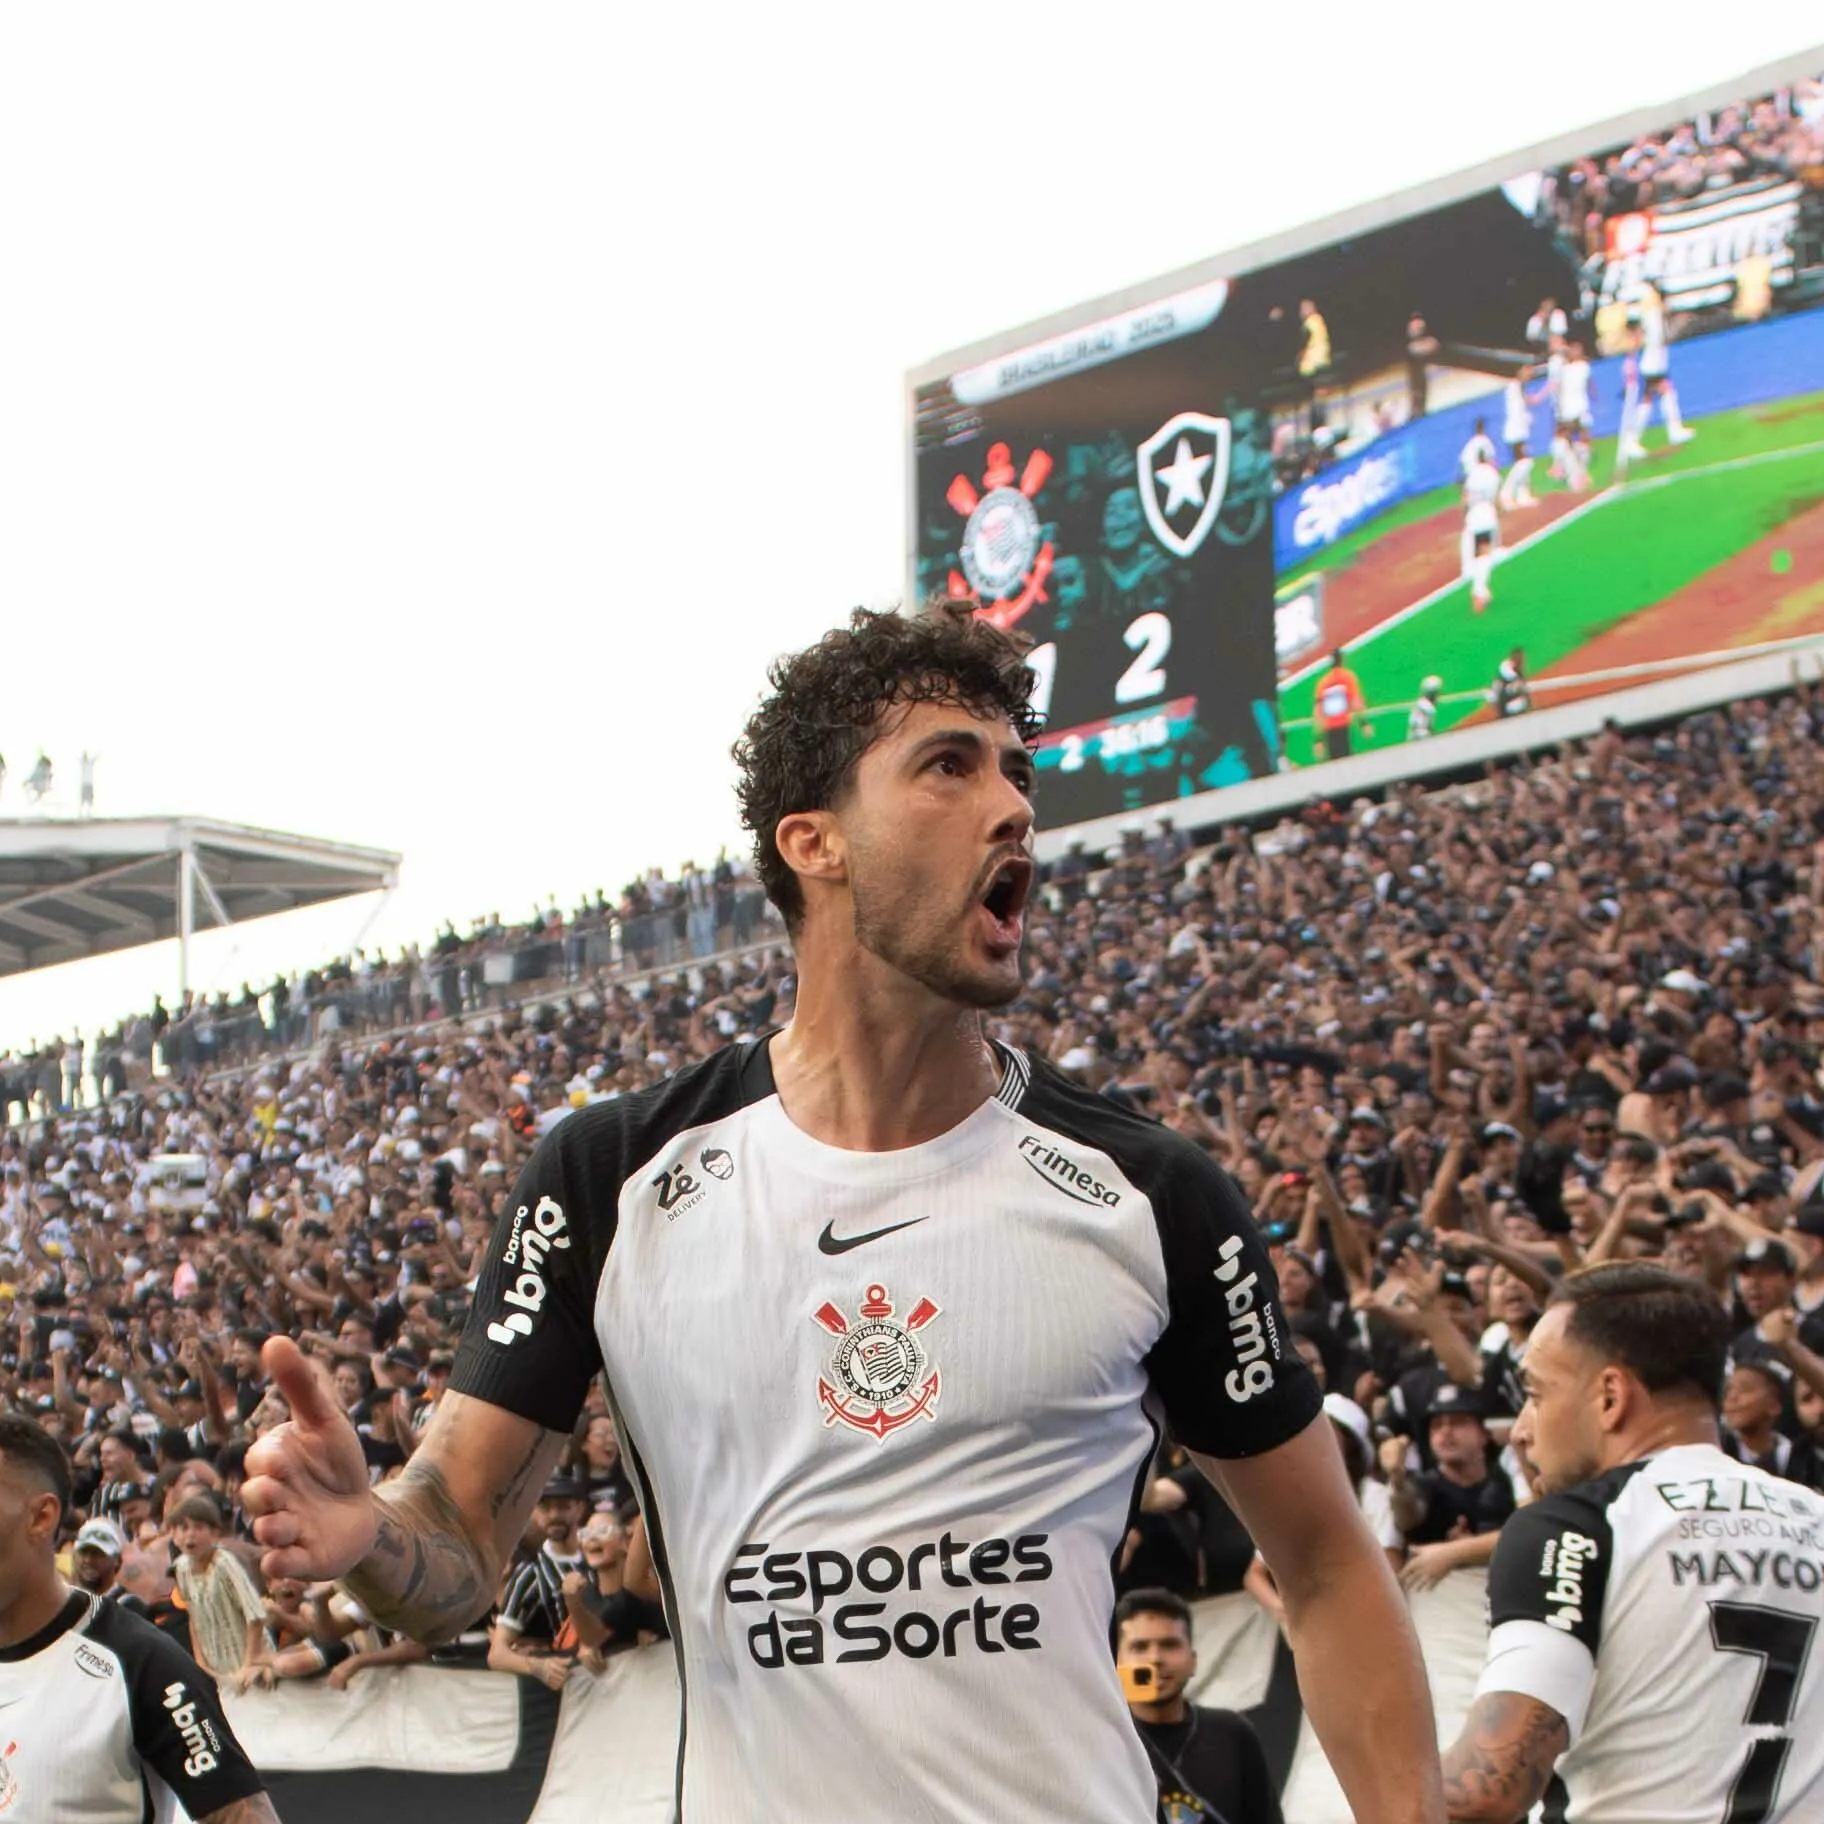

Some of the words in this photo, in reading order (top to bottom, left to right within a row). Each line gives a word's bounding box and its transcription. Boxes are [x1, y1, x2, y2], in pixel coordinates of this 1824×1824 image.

[1114, 611, 1172, 704] 2
[652, 1164, 701, 1211] Zé
[1018, 1135, 1121, 1208] Frimesa
[503, 1205, 529, 1265] banco
[667, 1191, 708, 1223] DELIVERY
[504, 1195, 571, 1313] bmg
[1224, 1271, 1275, 1404] bmg
[1263, 1302, 1280, 1361] banco
[868, 1389, 895, 1401] 1910
[1656, 1477, 1787, 1519] EZZE
[1679, 1517, 1773, 1540] SEGURO
[725, 1531, 1052, 1615] Esportes
[1545, 1530, 1599, 1606] bmg
[747, 1610, 824, 1669] da
[832, 1595, 1042, 1664] Sorte
[172, 1702, 218, 1778] bmg
[200, 1719, 221, 1753] banco
